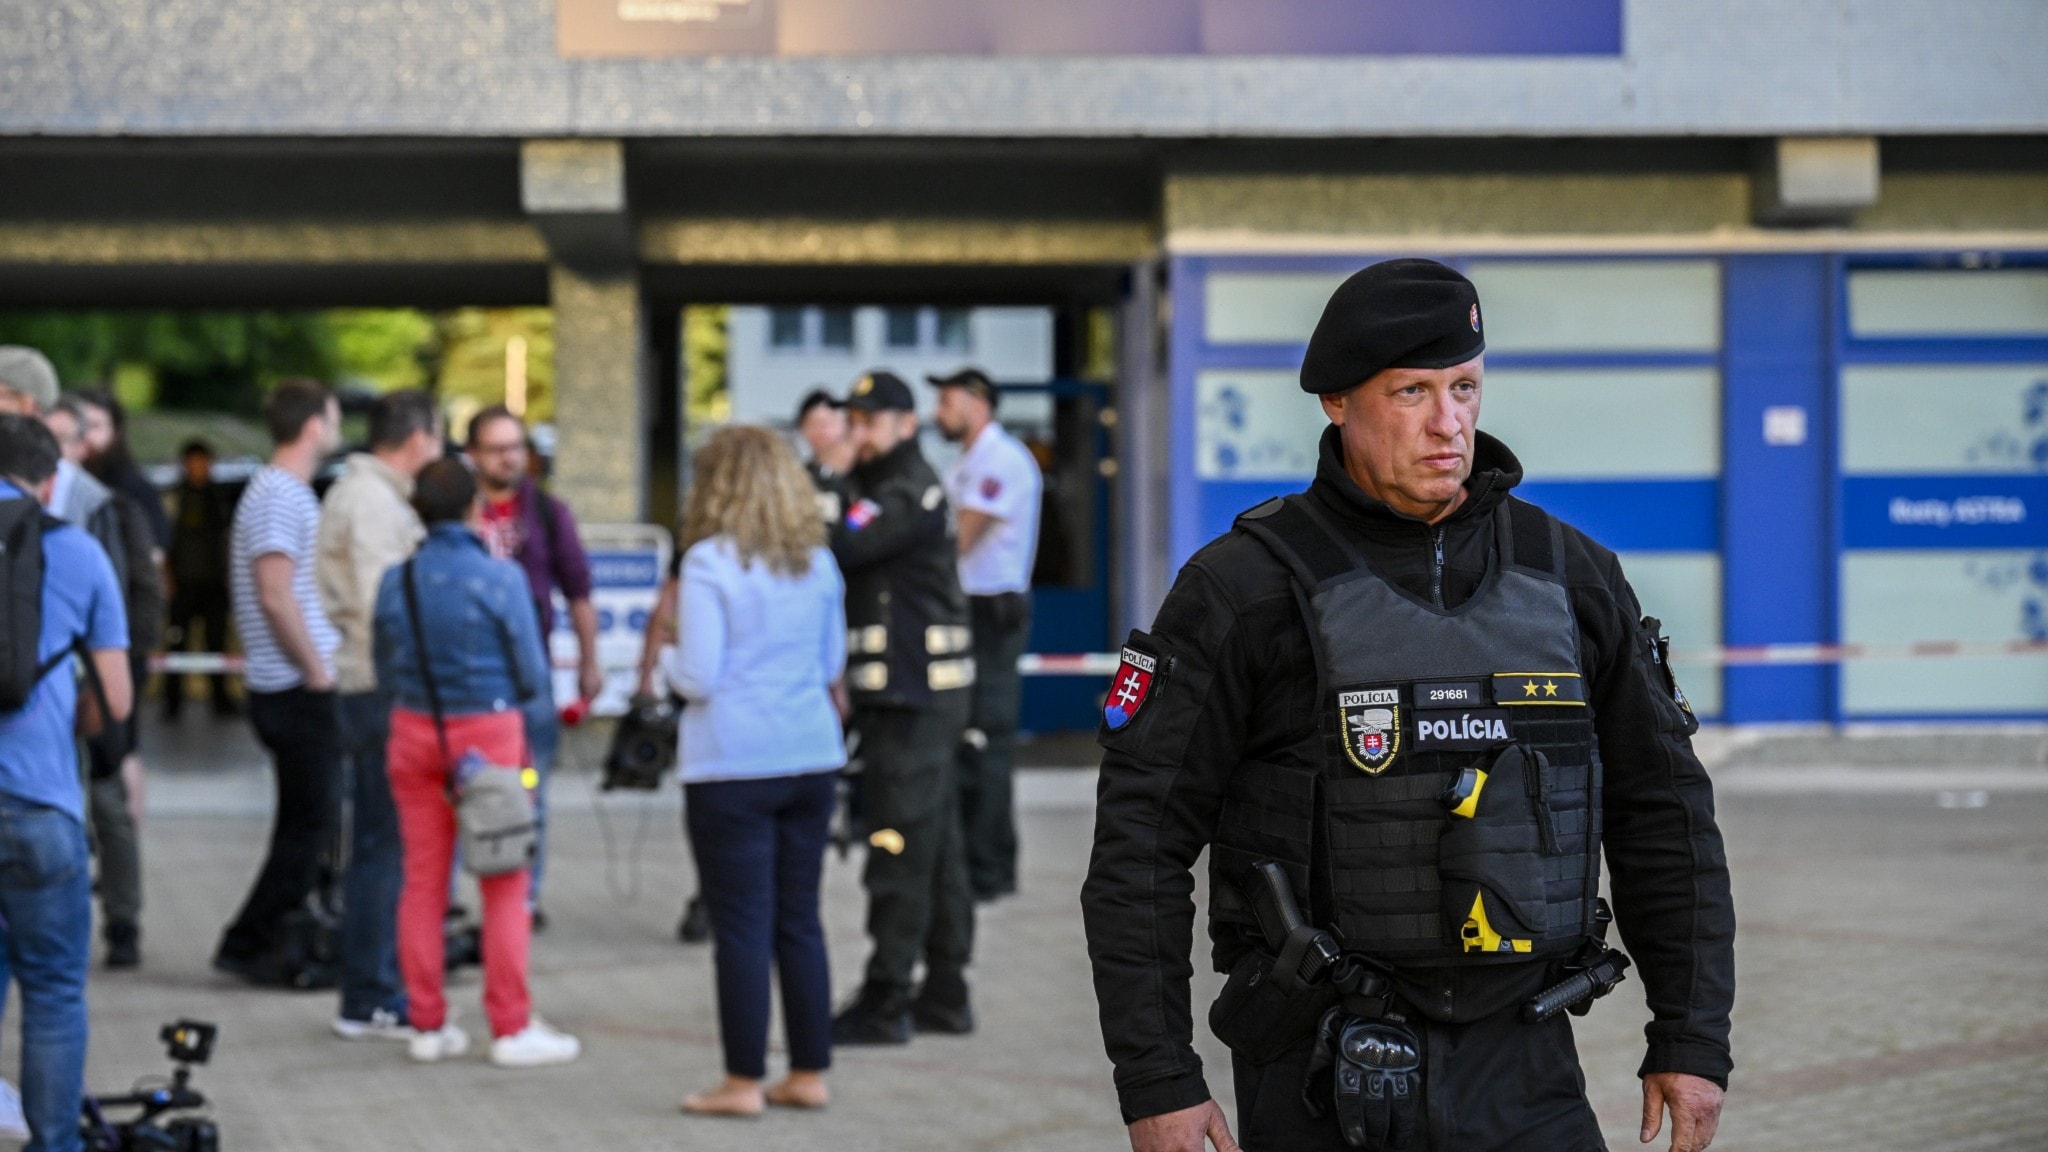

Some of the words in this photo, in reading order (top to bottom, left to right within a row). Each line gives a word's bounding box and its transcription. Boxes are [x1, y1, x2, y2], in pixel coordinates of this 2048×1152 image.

[1123, 650, 1154, 671] POLÍCIA
[1343, 692, 1394, 705] POLÍCIA
[1430, 689, 1468, 700] 291681
[1418, 713, 1508, 741] POLÍCIA
